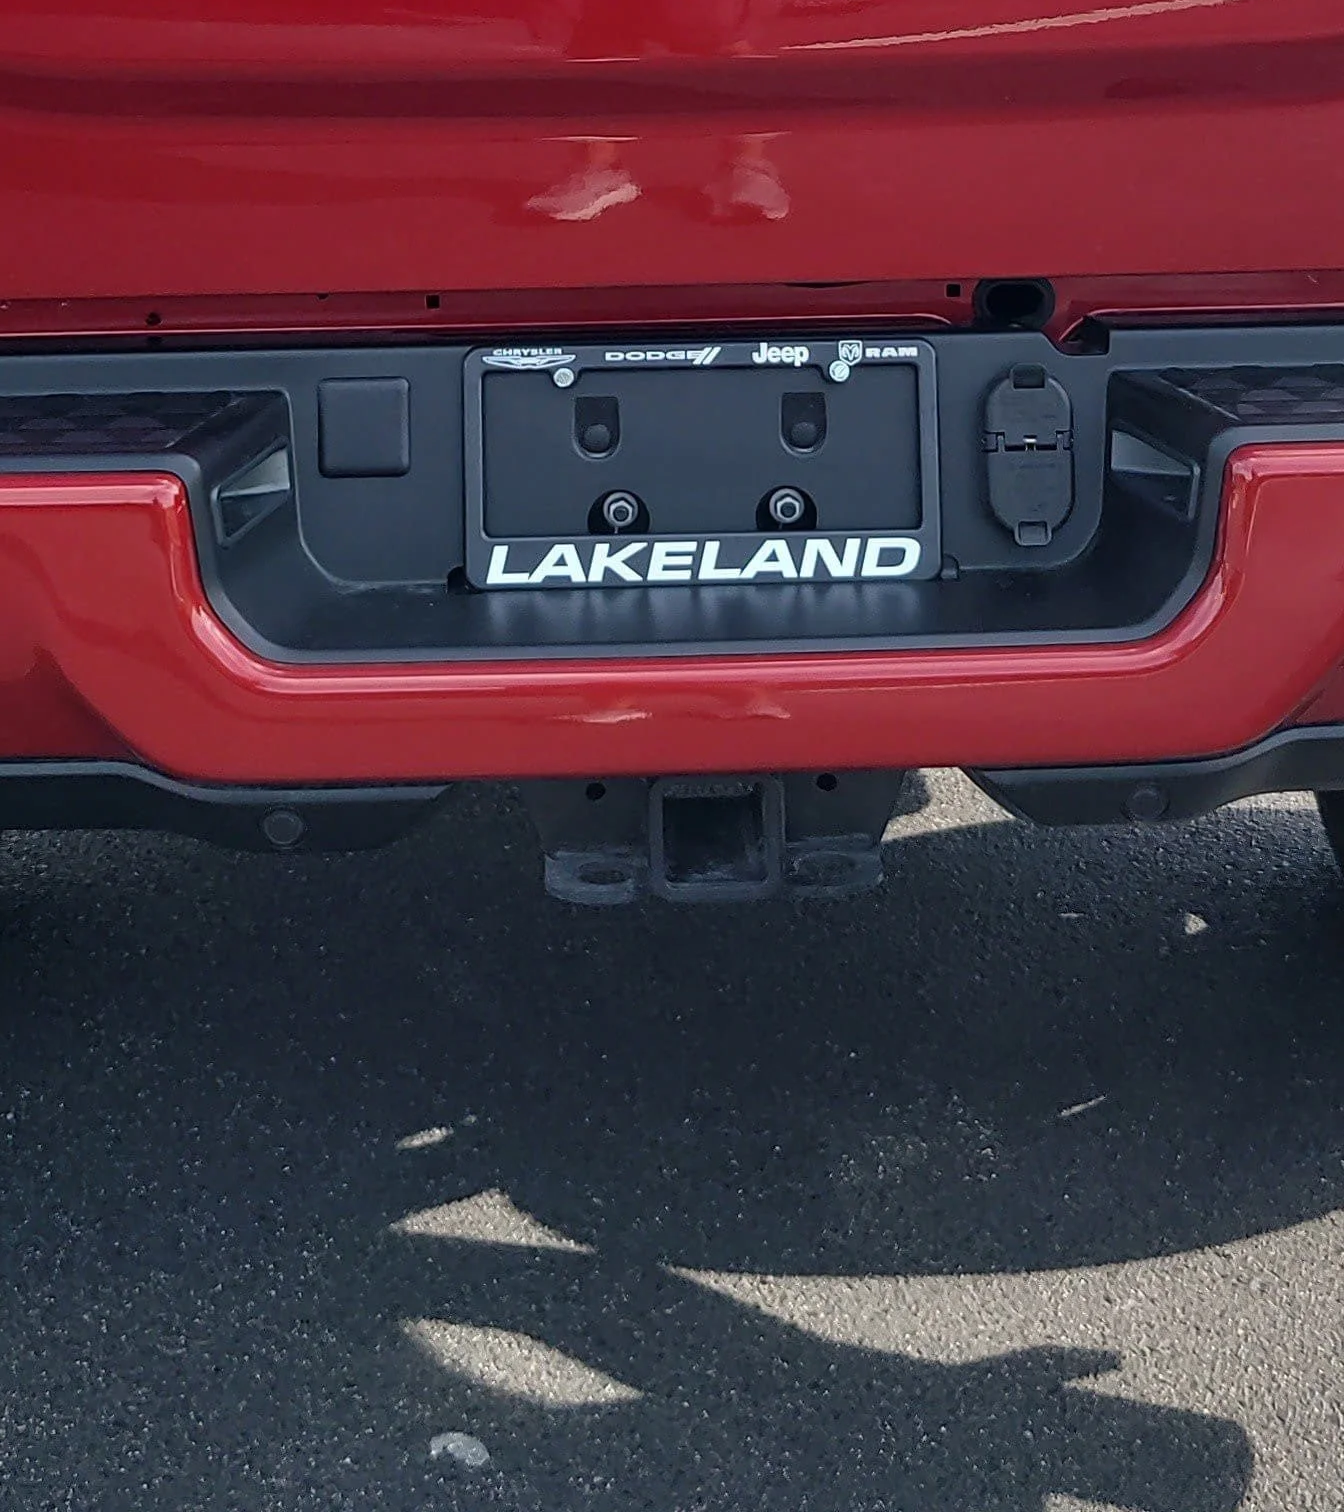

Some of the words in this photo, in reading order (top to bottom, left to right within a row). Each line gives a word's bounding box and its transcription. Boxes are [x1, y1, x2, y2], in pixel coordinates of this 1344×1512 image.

[493, 348, 562, 356] CHRYSLER
[605, 349, 702, 361] DODGE
[752, 342, 809, 366] Jeep
[865, 347, 918, 358] RAM
[486, 537, 921, 585] LAKELAND
